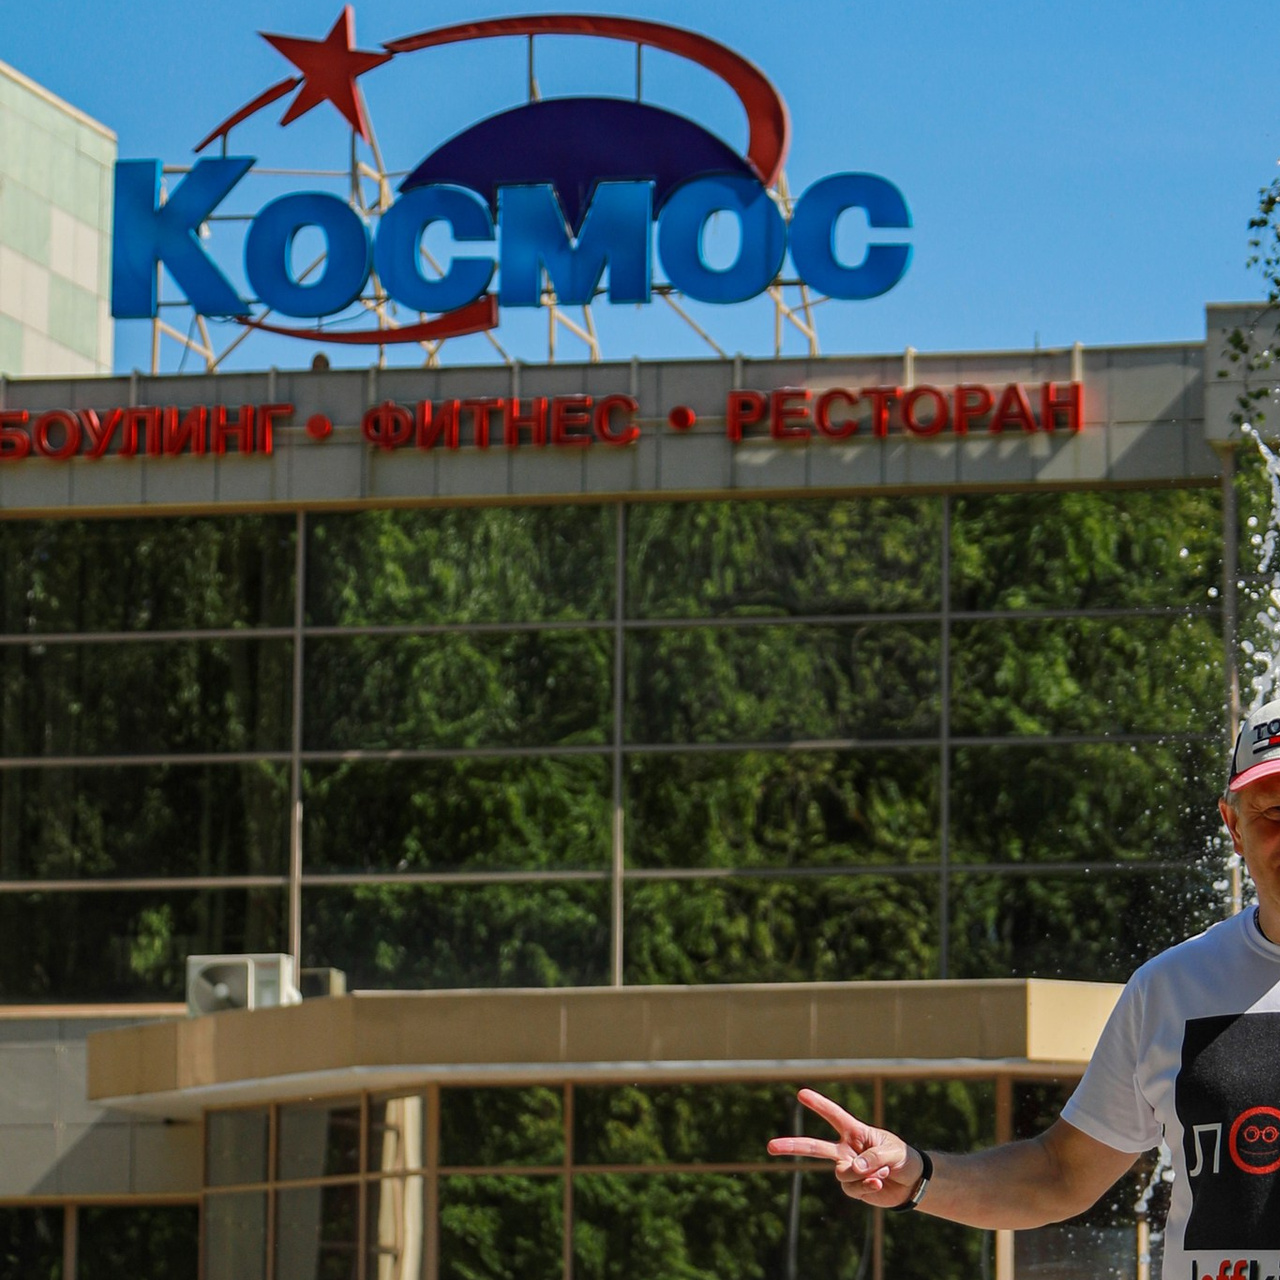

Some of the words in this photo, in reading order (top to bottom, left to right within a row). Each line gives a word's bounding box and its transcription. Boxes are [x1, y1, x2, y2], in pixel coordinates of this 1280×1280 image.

[0, 404, 294, 462] БОУЛИНГ
[362, 393, 641, 451] ФИТНЕС
[727, 381, 1084, 443] РЕСТОРАН
